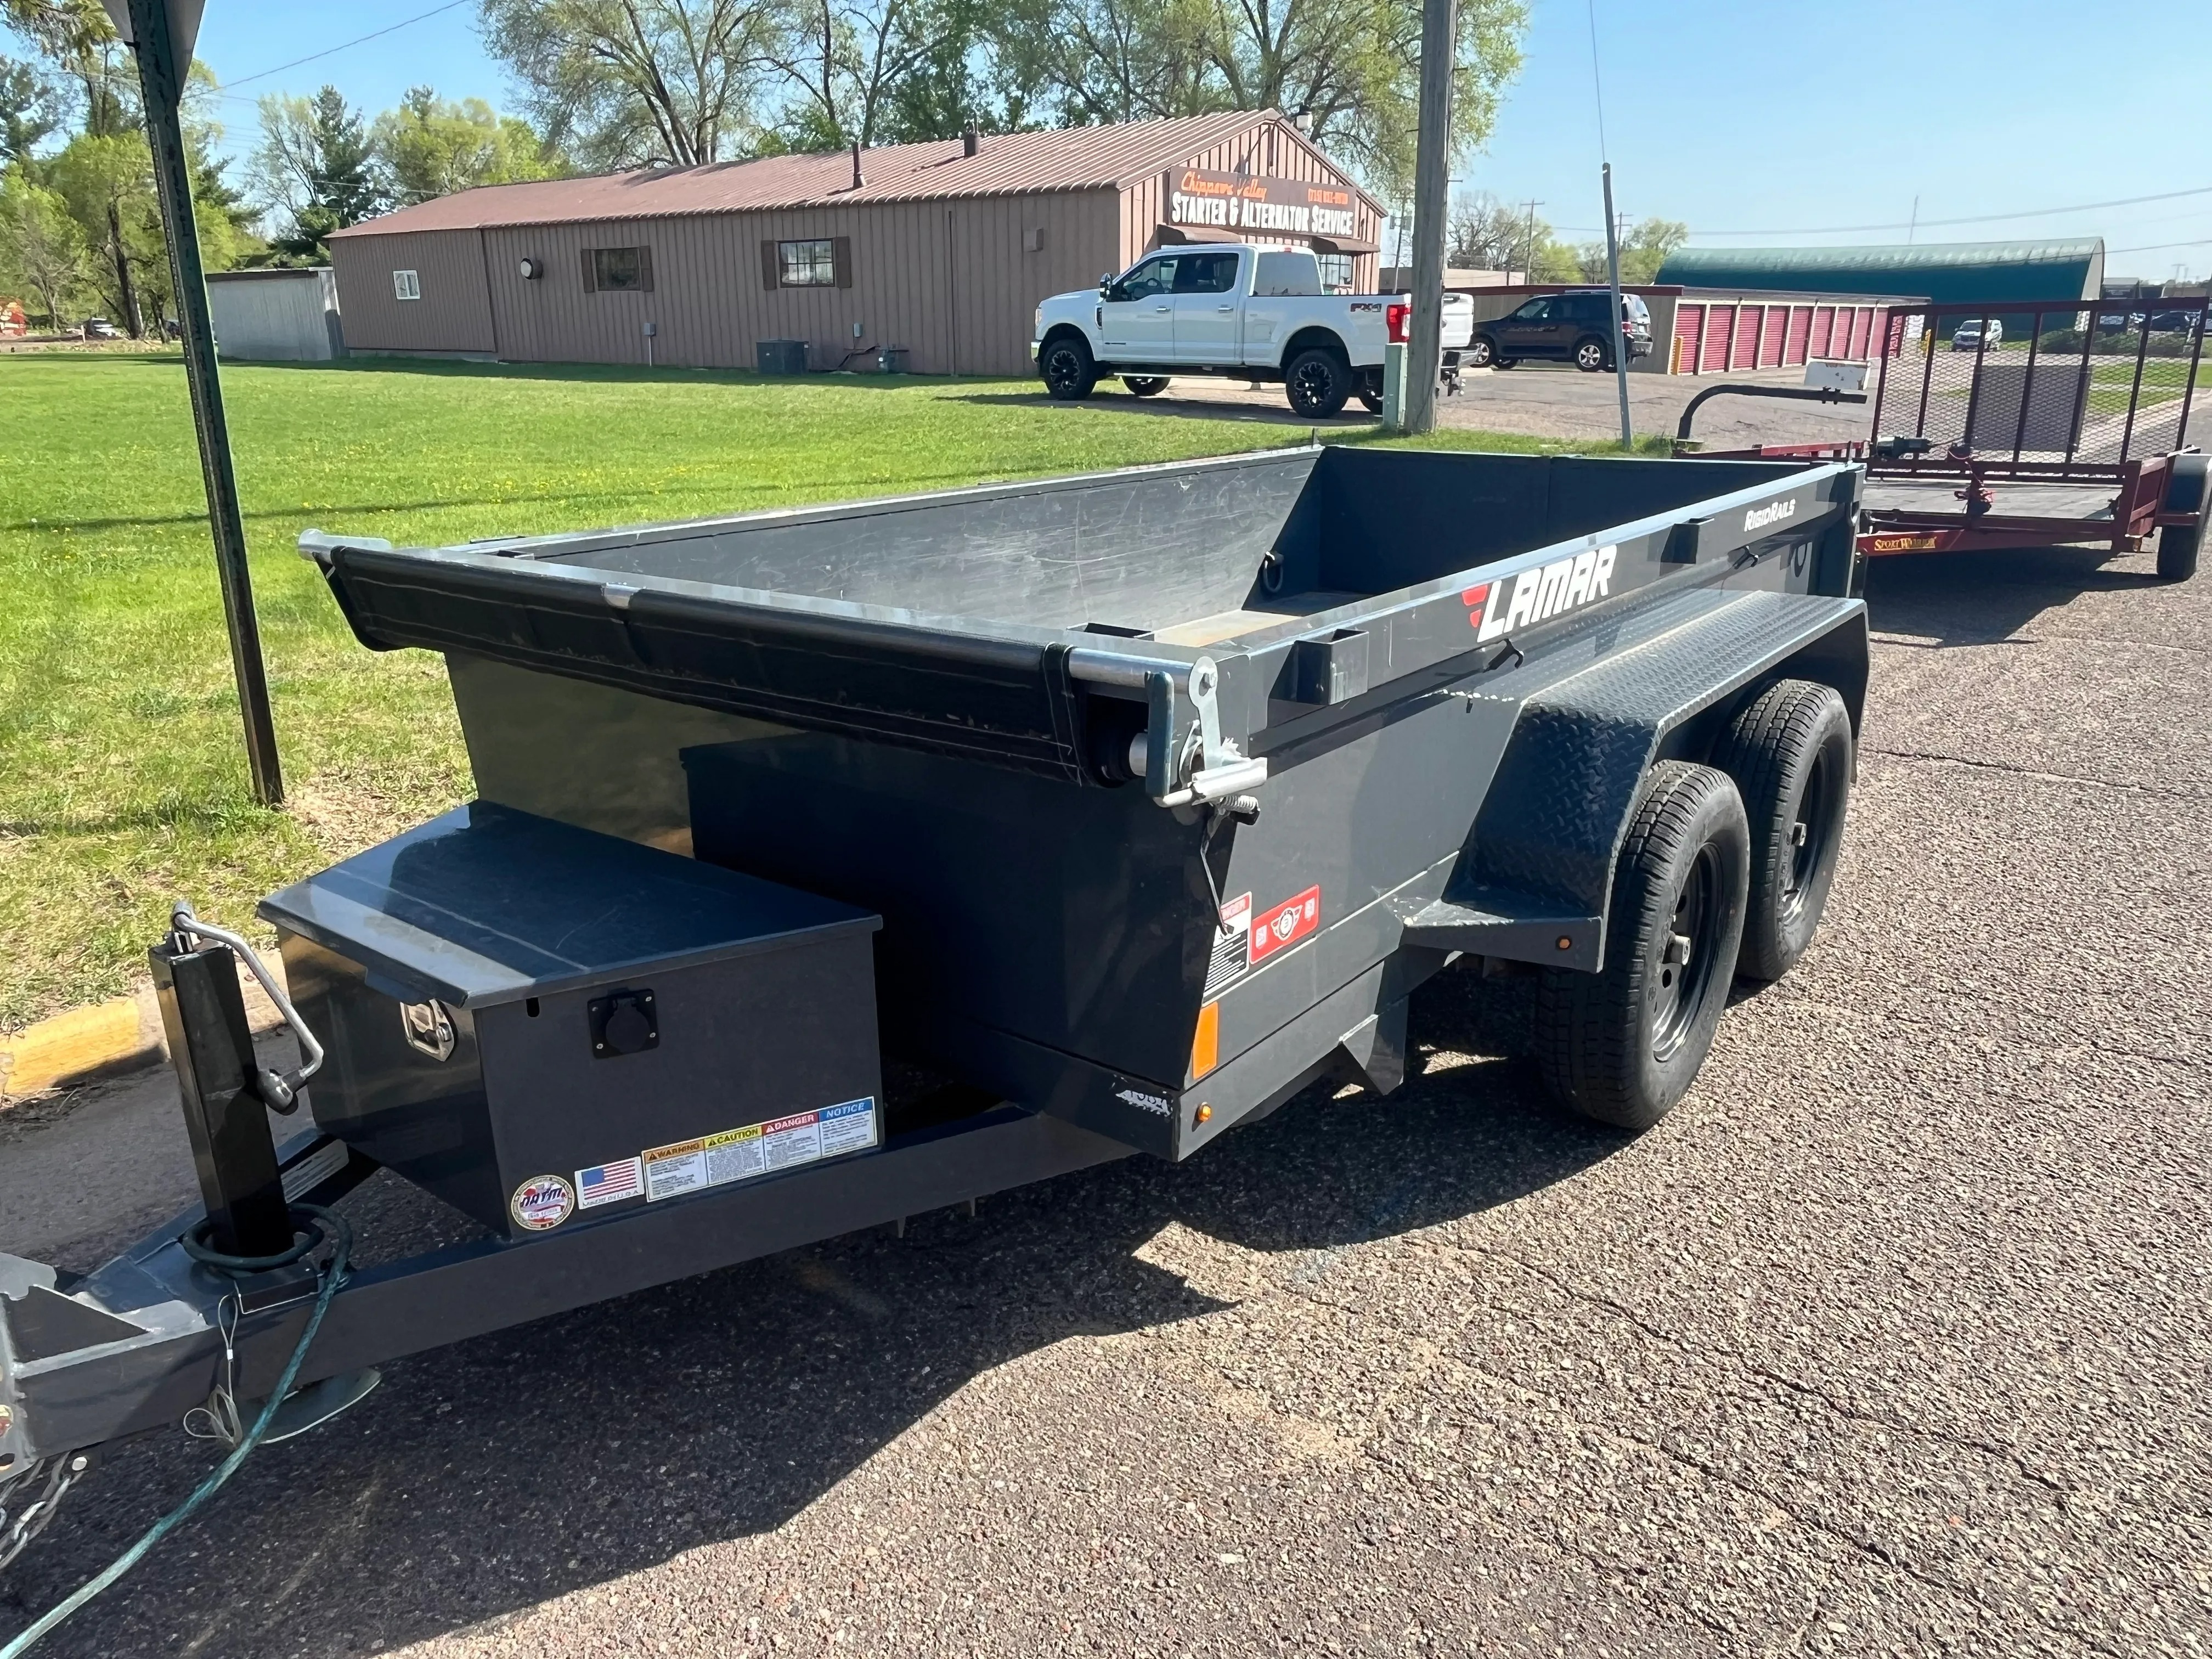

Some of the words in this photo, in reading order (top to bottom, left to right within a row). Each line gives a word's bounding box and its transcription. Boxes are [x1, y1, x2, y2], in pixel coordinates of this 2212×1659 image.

[1181, 171, 1234, 196] Chippewa
[1237, 178, 1267, 202] Valley
[1172, 191, 1227, 225] STARTER
[1240, 198, 1310, 232] ALTERNATOR
[1312, 205, 1353, 235] SERVICE
[1477, 545, 1618, 643] LAMAR
[826, 1102, 865, 1119] NOTICE
[775, 1114, 815, 1131] DANGER
[717, 1127, 759, 1144] CAUTION
[657, 1143, 699, 1158] WARNING
